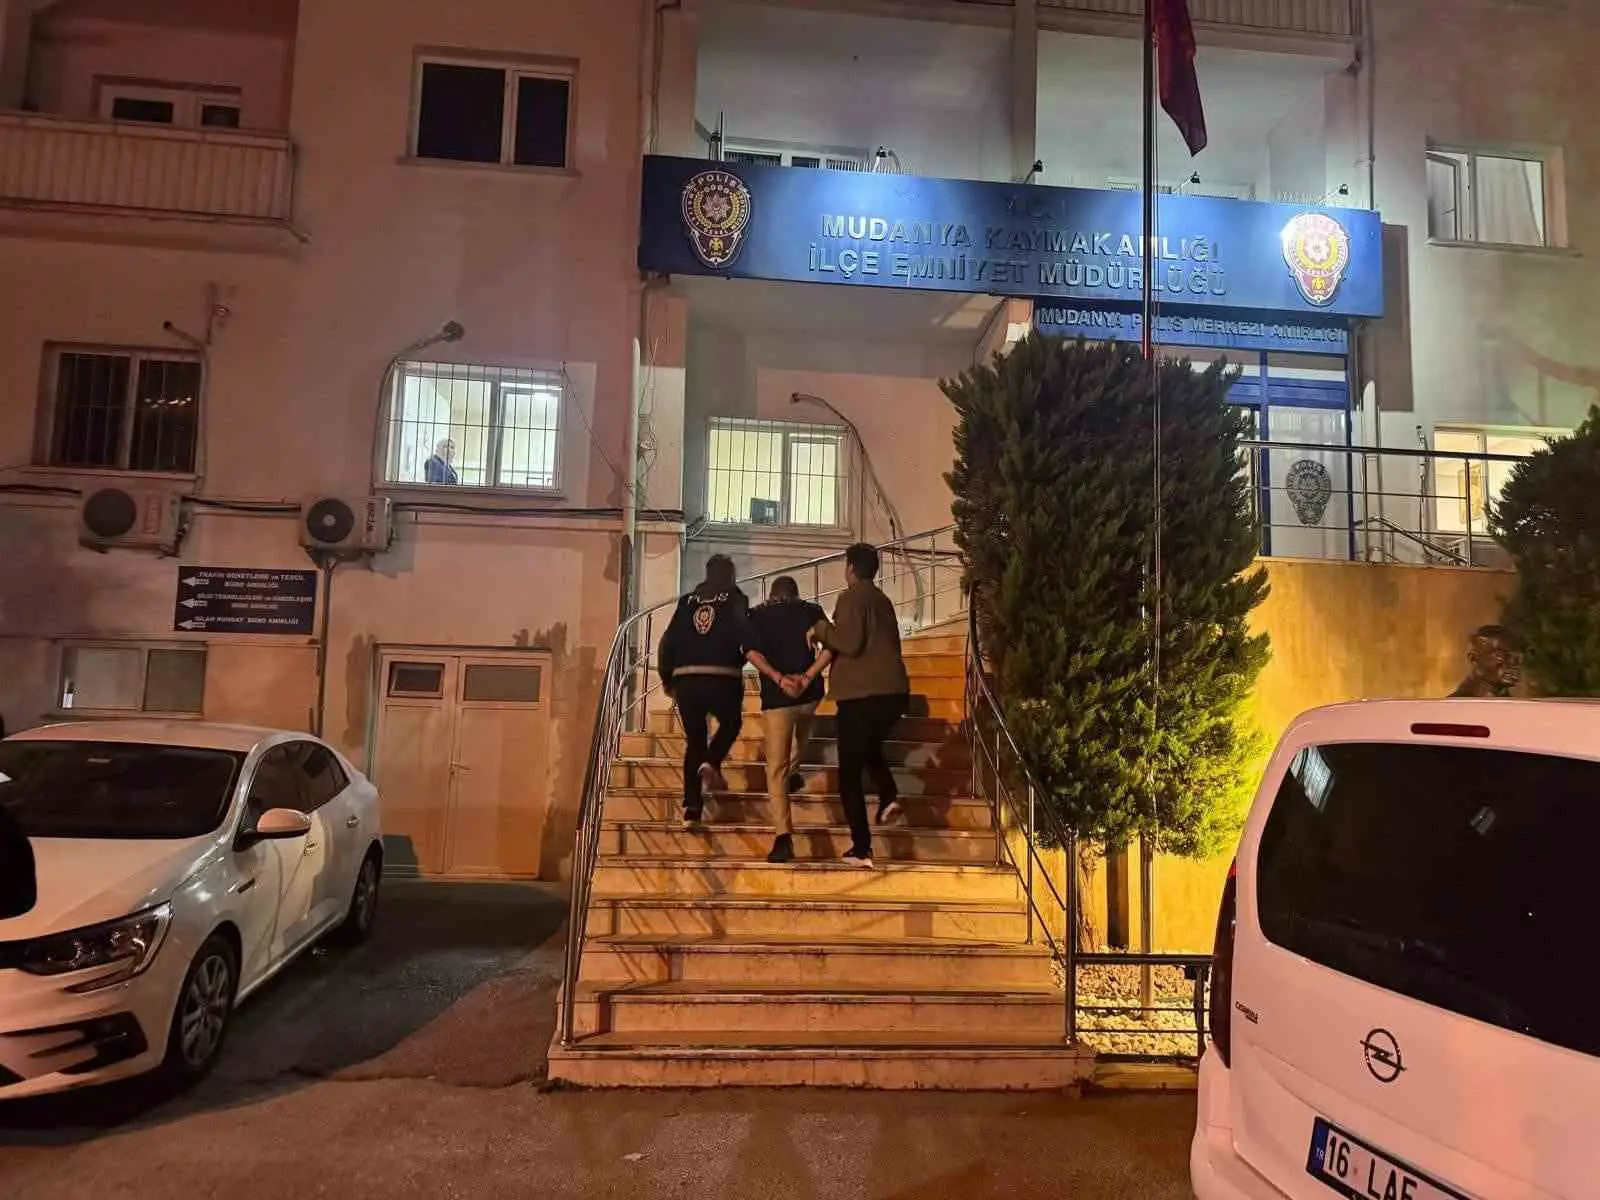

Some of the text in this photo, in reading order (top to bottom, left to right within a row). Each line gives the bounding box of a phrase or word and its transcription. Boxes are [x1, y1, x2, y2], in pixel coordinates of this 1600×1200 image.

[821, 213, 971, 248] MUDANYA
[808, 241, 881, 279] İLÇE
[891, 252, 1030, 284] EMNİYET
[1131, 311, 1185, 333] PLİS
[1328, 1135, 1351, 1178] 16
